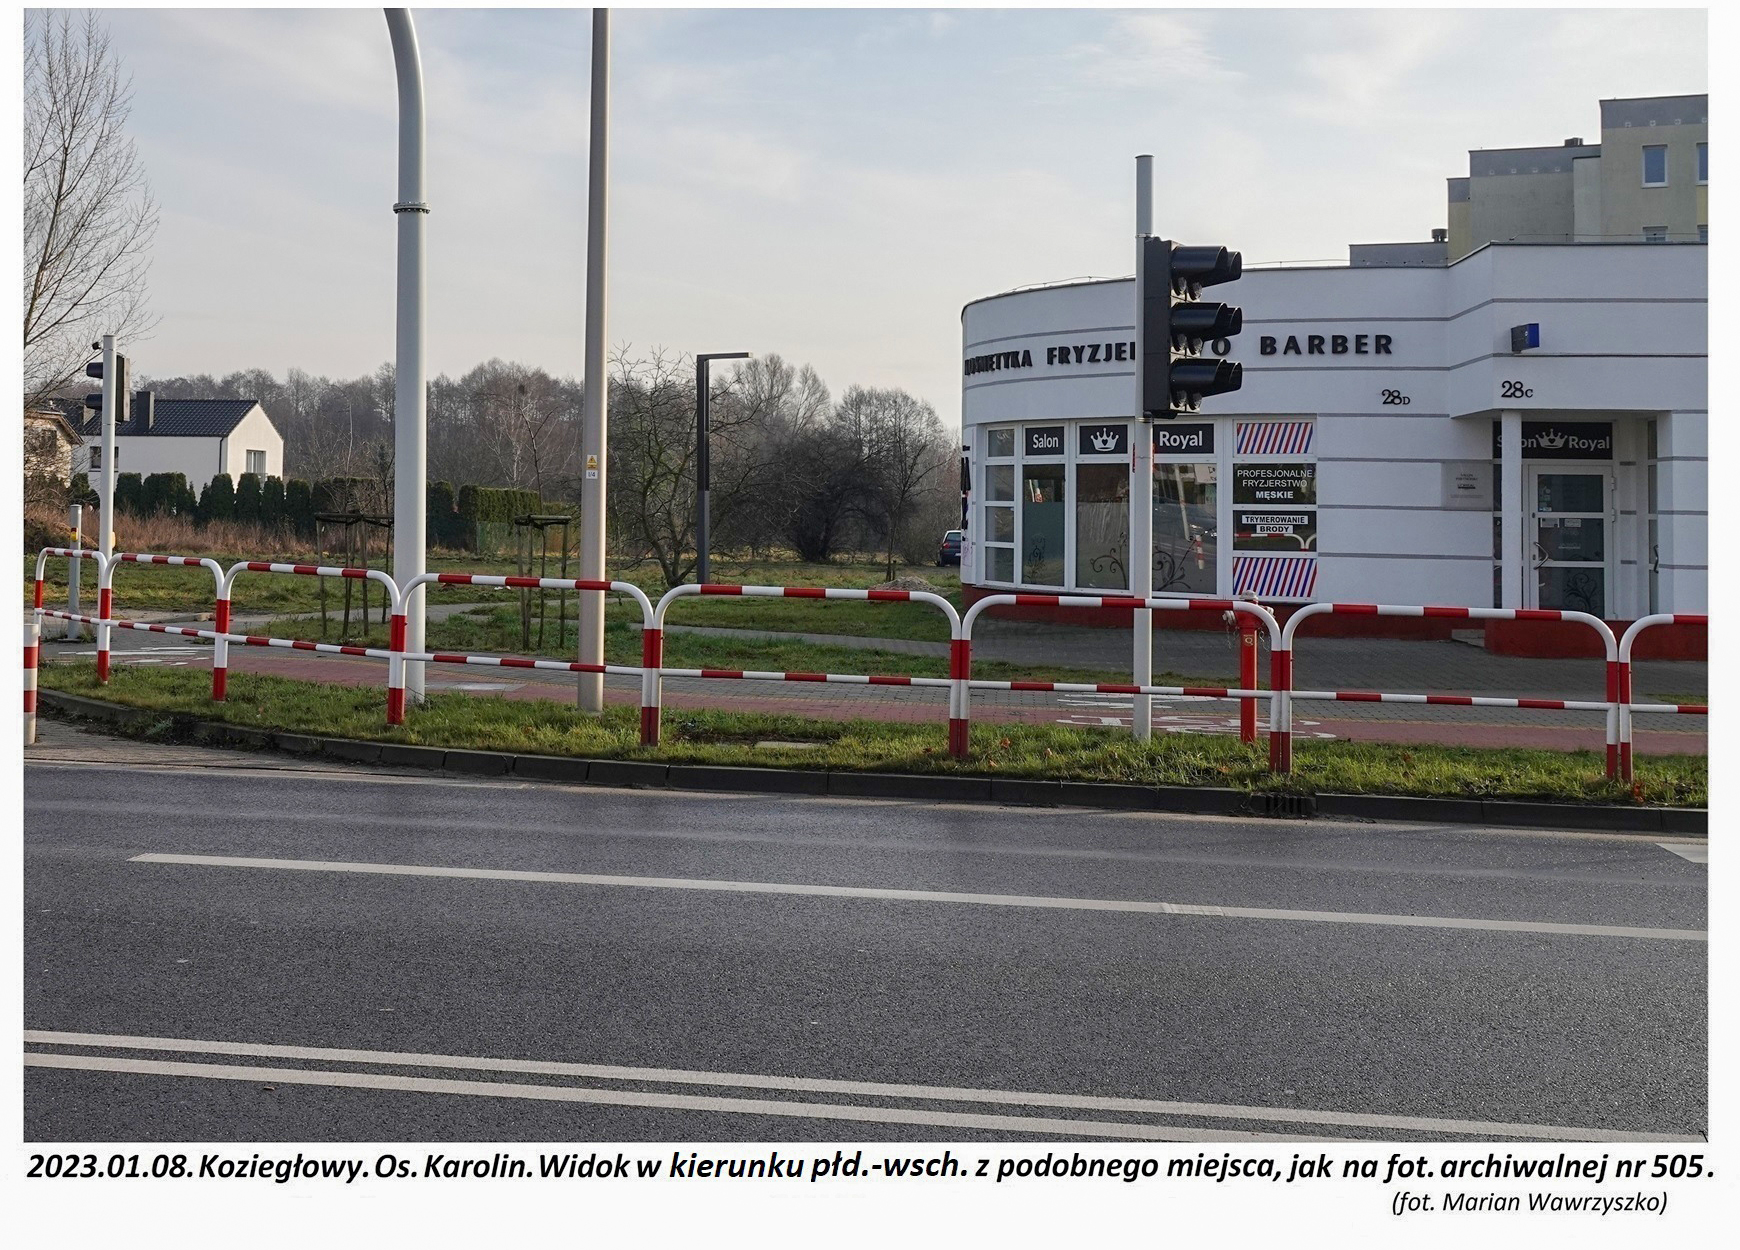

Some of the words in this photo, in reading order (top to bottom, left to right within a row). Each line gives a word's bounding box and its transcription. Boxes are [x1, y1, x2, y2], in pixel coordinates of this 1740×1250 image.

[1046, 337, 1231, 365] FRYZJEO
[1260, 334, 1393, 355] BARBER
[1381, 389, 1410, 405] 28D
[1032, 434, 1059, 448] Salon
[1159, 431, 1203, 450] Royal
[1569, 436, 1609, 451] Royal
[1237, 469, 1313, 478] PROFESJONALNE
[1242, 479, 1308, 488] FRYZJERSTWO
[1255, 491, 1294, 500] MĘSKIE
[1245, 516, 1305, 524] TRYMEROWANIE
